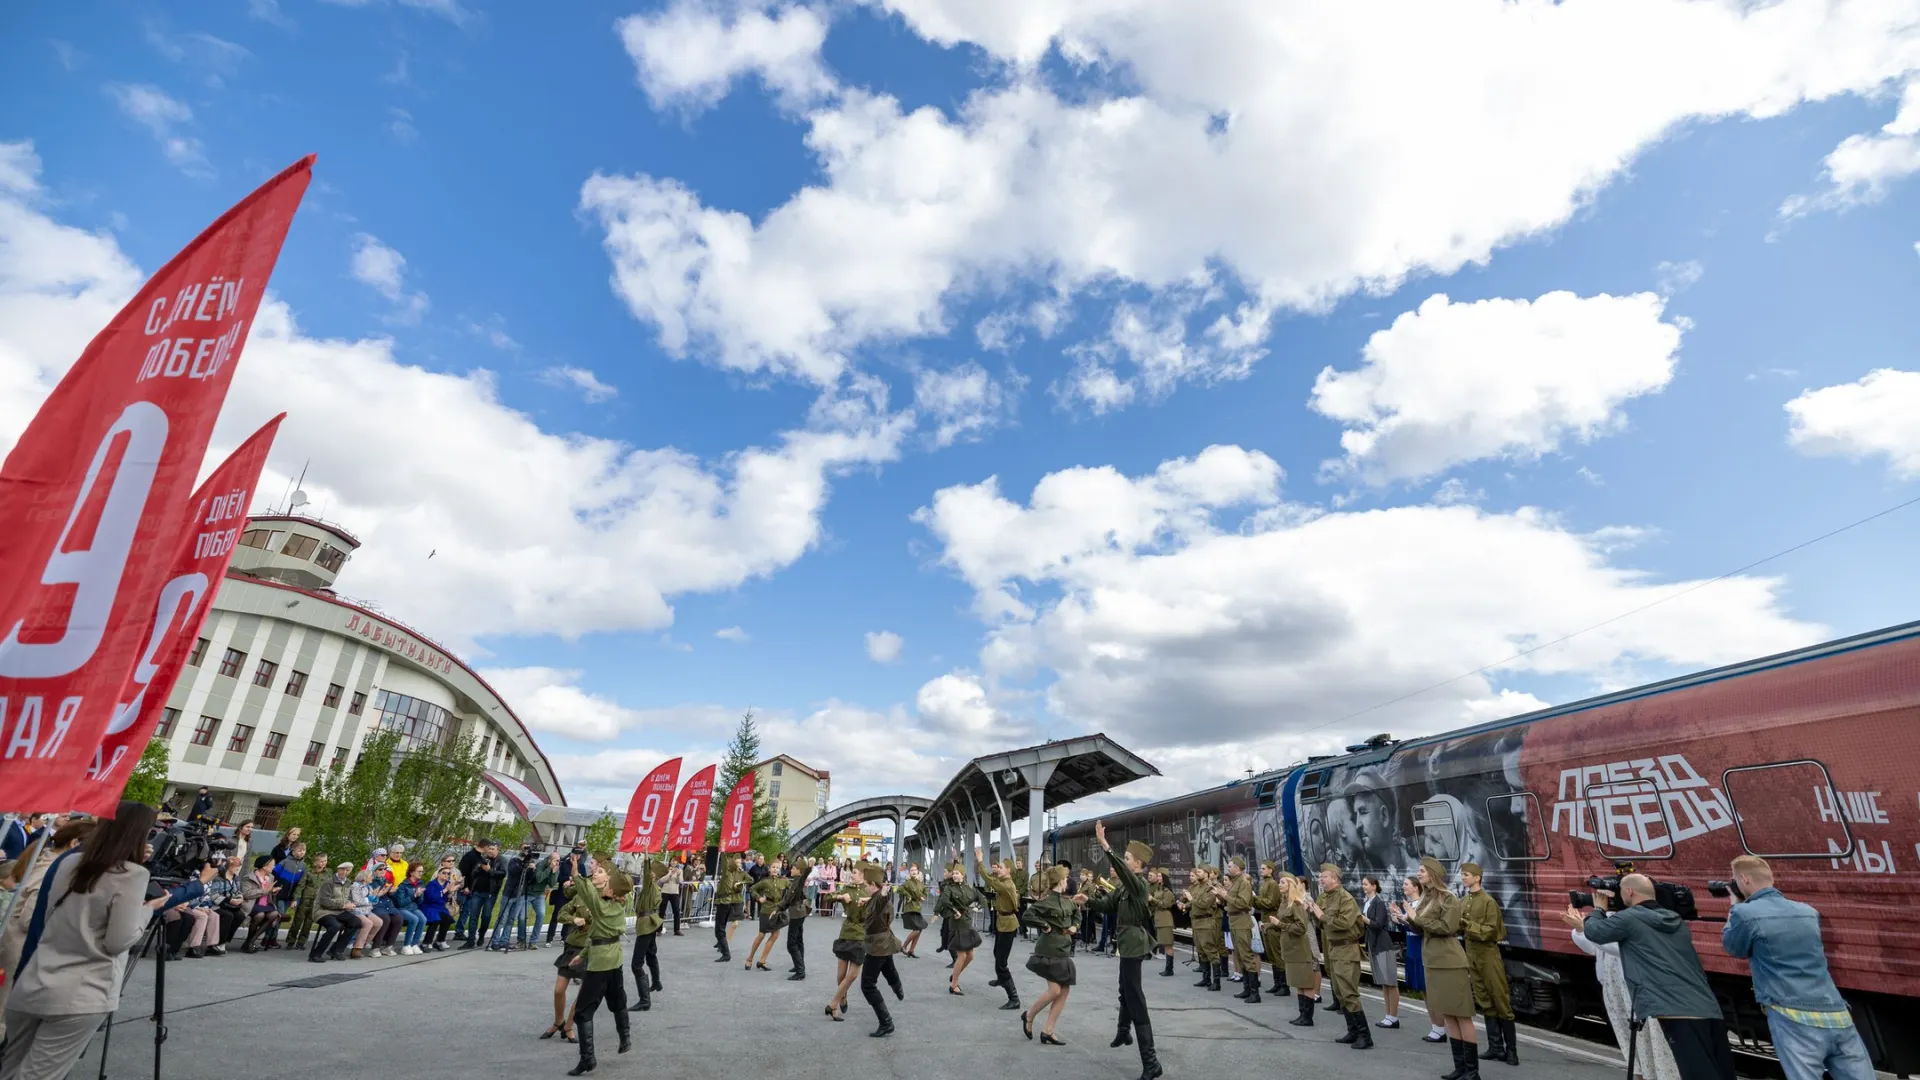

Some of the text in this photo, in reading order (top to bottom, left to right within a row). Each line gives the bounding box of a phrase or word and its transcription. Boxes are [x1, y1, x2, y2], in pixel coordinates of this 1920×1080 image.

[144, 297, 167, 336] С
[0, 401, 169, 679] 9
[345, 614, 453, 675] ЛАБЫТНАНГИ
[1558, 753, 1711, 801] ПОЕЗД
[638, 793, 661, 835] 9
[680, 798, 699, 836] 9
[731, 803, 745, 838] 9
[1551, 788, 1744, 853] ПОБЕДЫ
[634, 836, 651, 847] МАЯ
[676, 836, 692, 845] МАЯ
[1827, 838, 1897, 875] МЫ
